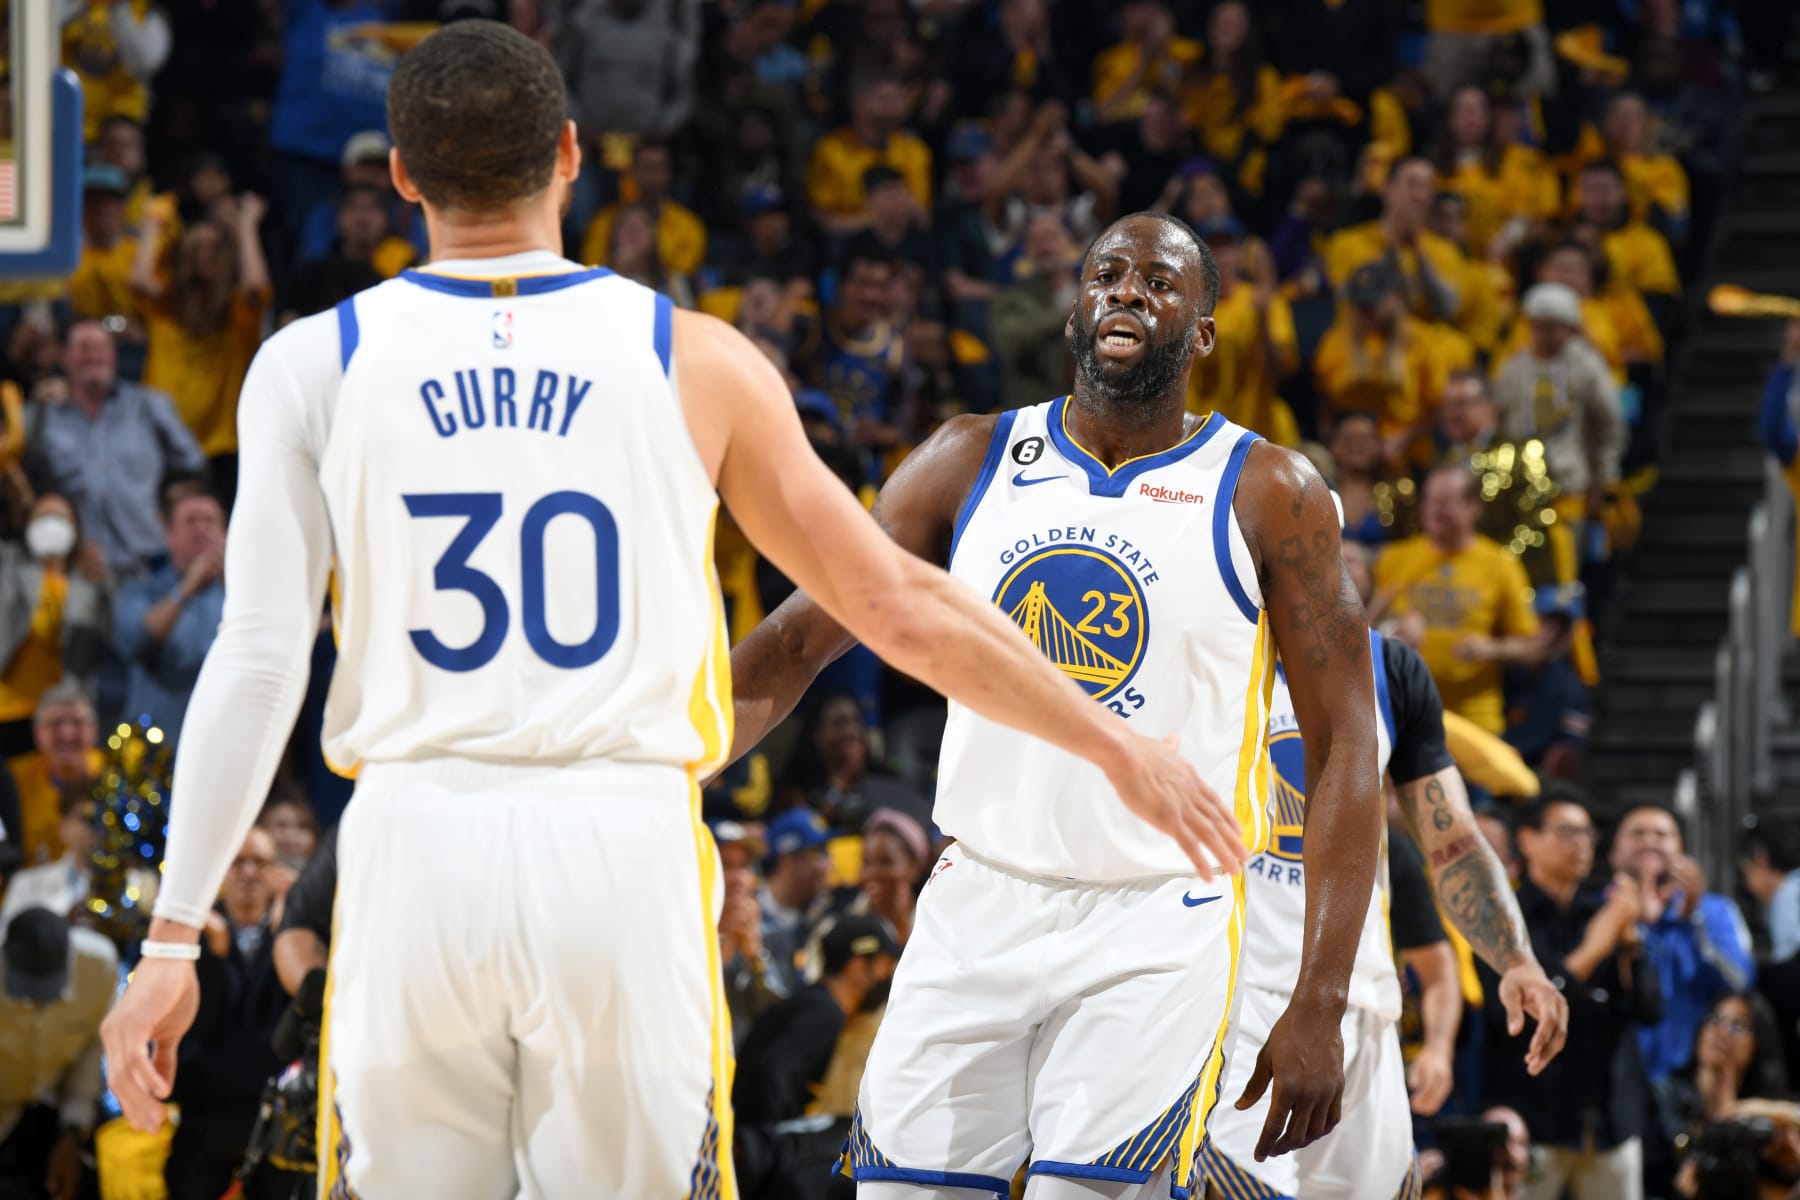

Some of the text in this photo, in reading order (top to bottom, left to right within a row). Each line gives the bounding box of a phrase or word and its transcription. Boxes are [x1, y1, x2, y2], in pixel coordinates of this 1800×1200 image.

[419, 367, 593, 438] CURRY
[1018, 440, 1039, 462] 6
[1139, 483, 1204, 504] Rakuten
[400, 490, 620, 672] 30
[1000, 526, 1159, 586] GOLDEN STATE
[1076, 590, 1135, 638] 23
